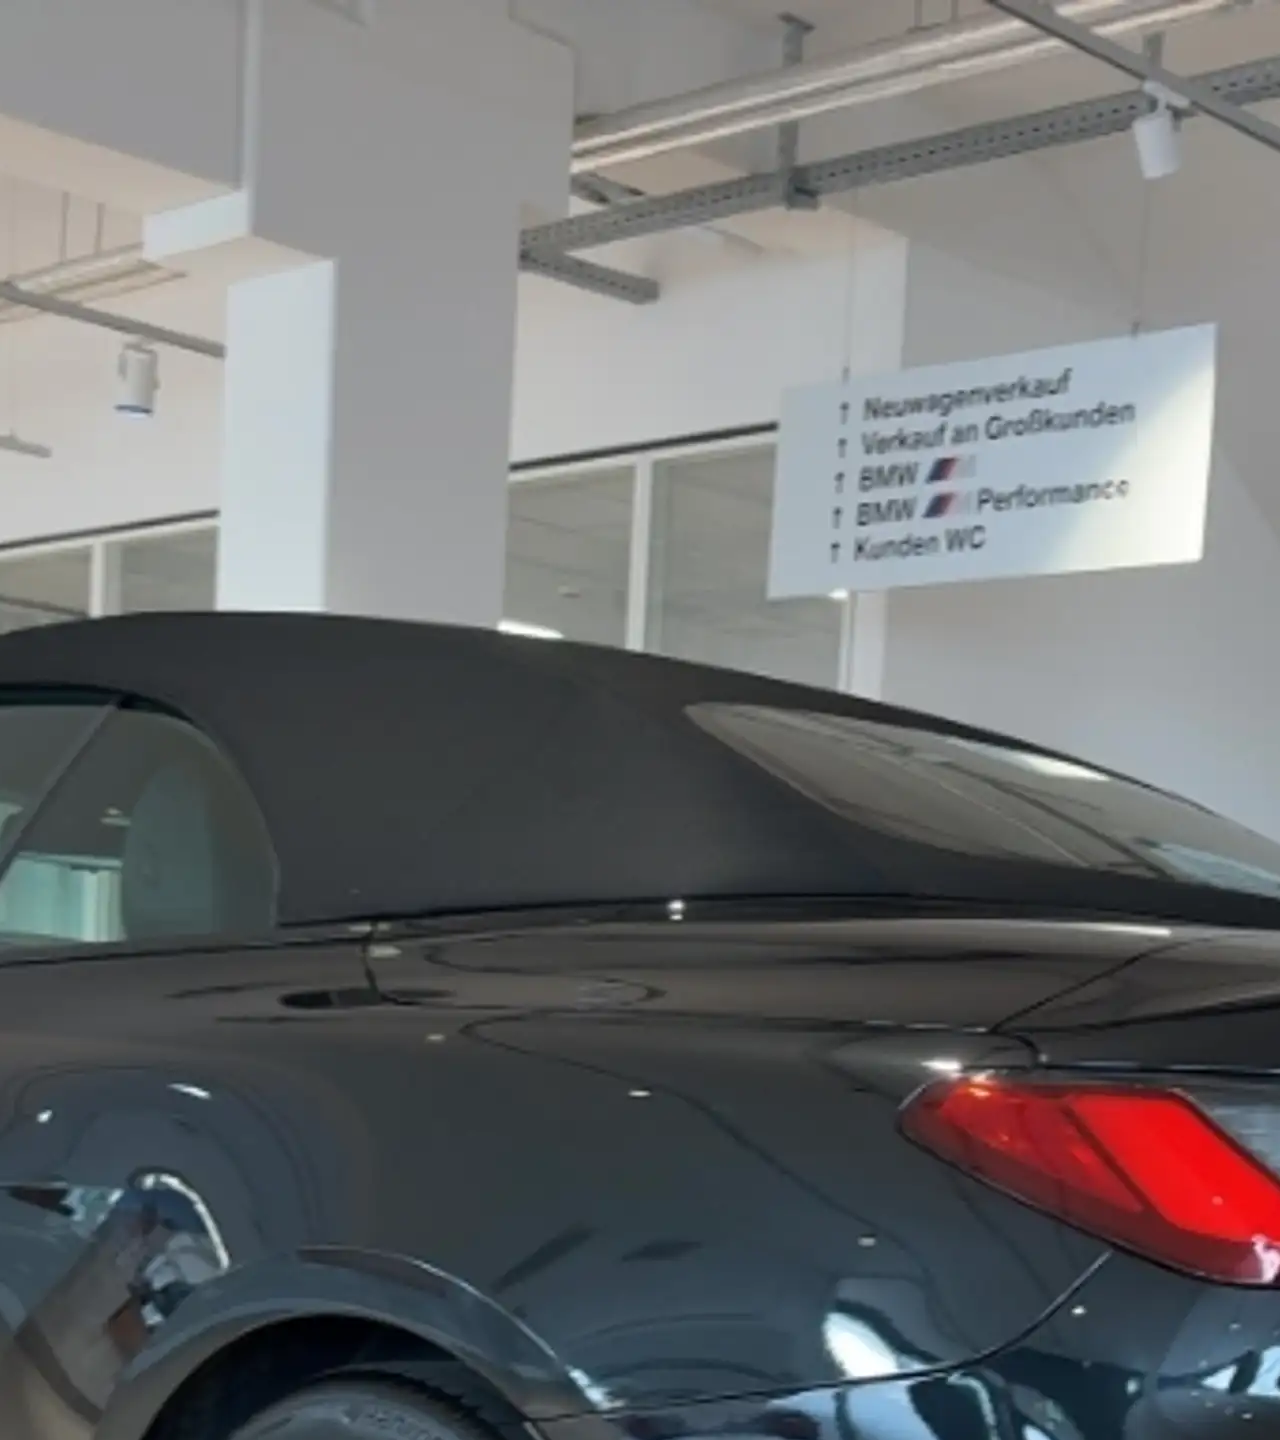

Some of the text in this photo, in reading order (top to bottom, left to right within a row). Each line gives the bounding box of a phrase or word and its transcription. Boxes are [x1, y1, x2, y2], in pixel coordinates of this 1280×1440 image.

[862, 367, 1073, 421] Neuwagenverkauf
[860, 401, 1136, 455] Verkauf an Großkunden
[858, 462, 919, 492] BMW
[856, 497, 917, 526] BMW
[977, 479, 1130, 515] Performance
[853, 524, 986, 562] Kunden WC
